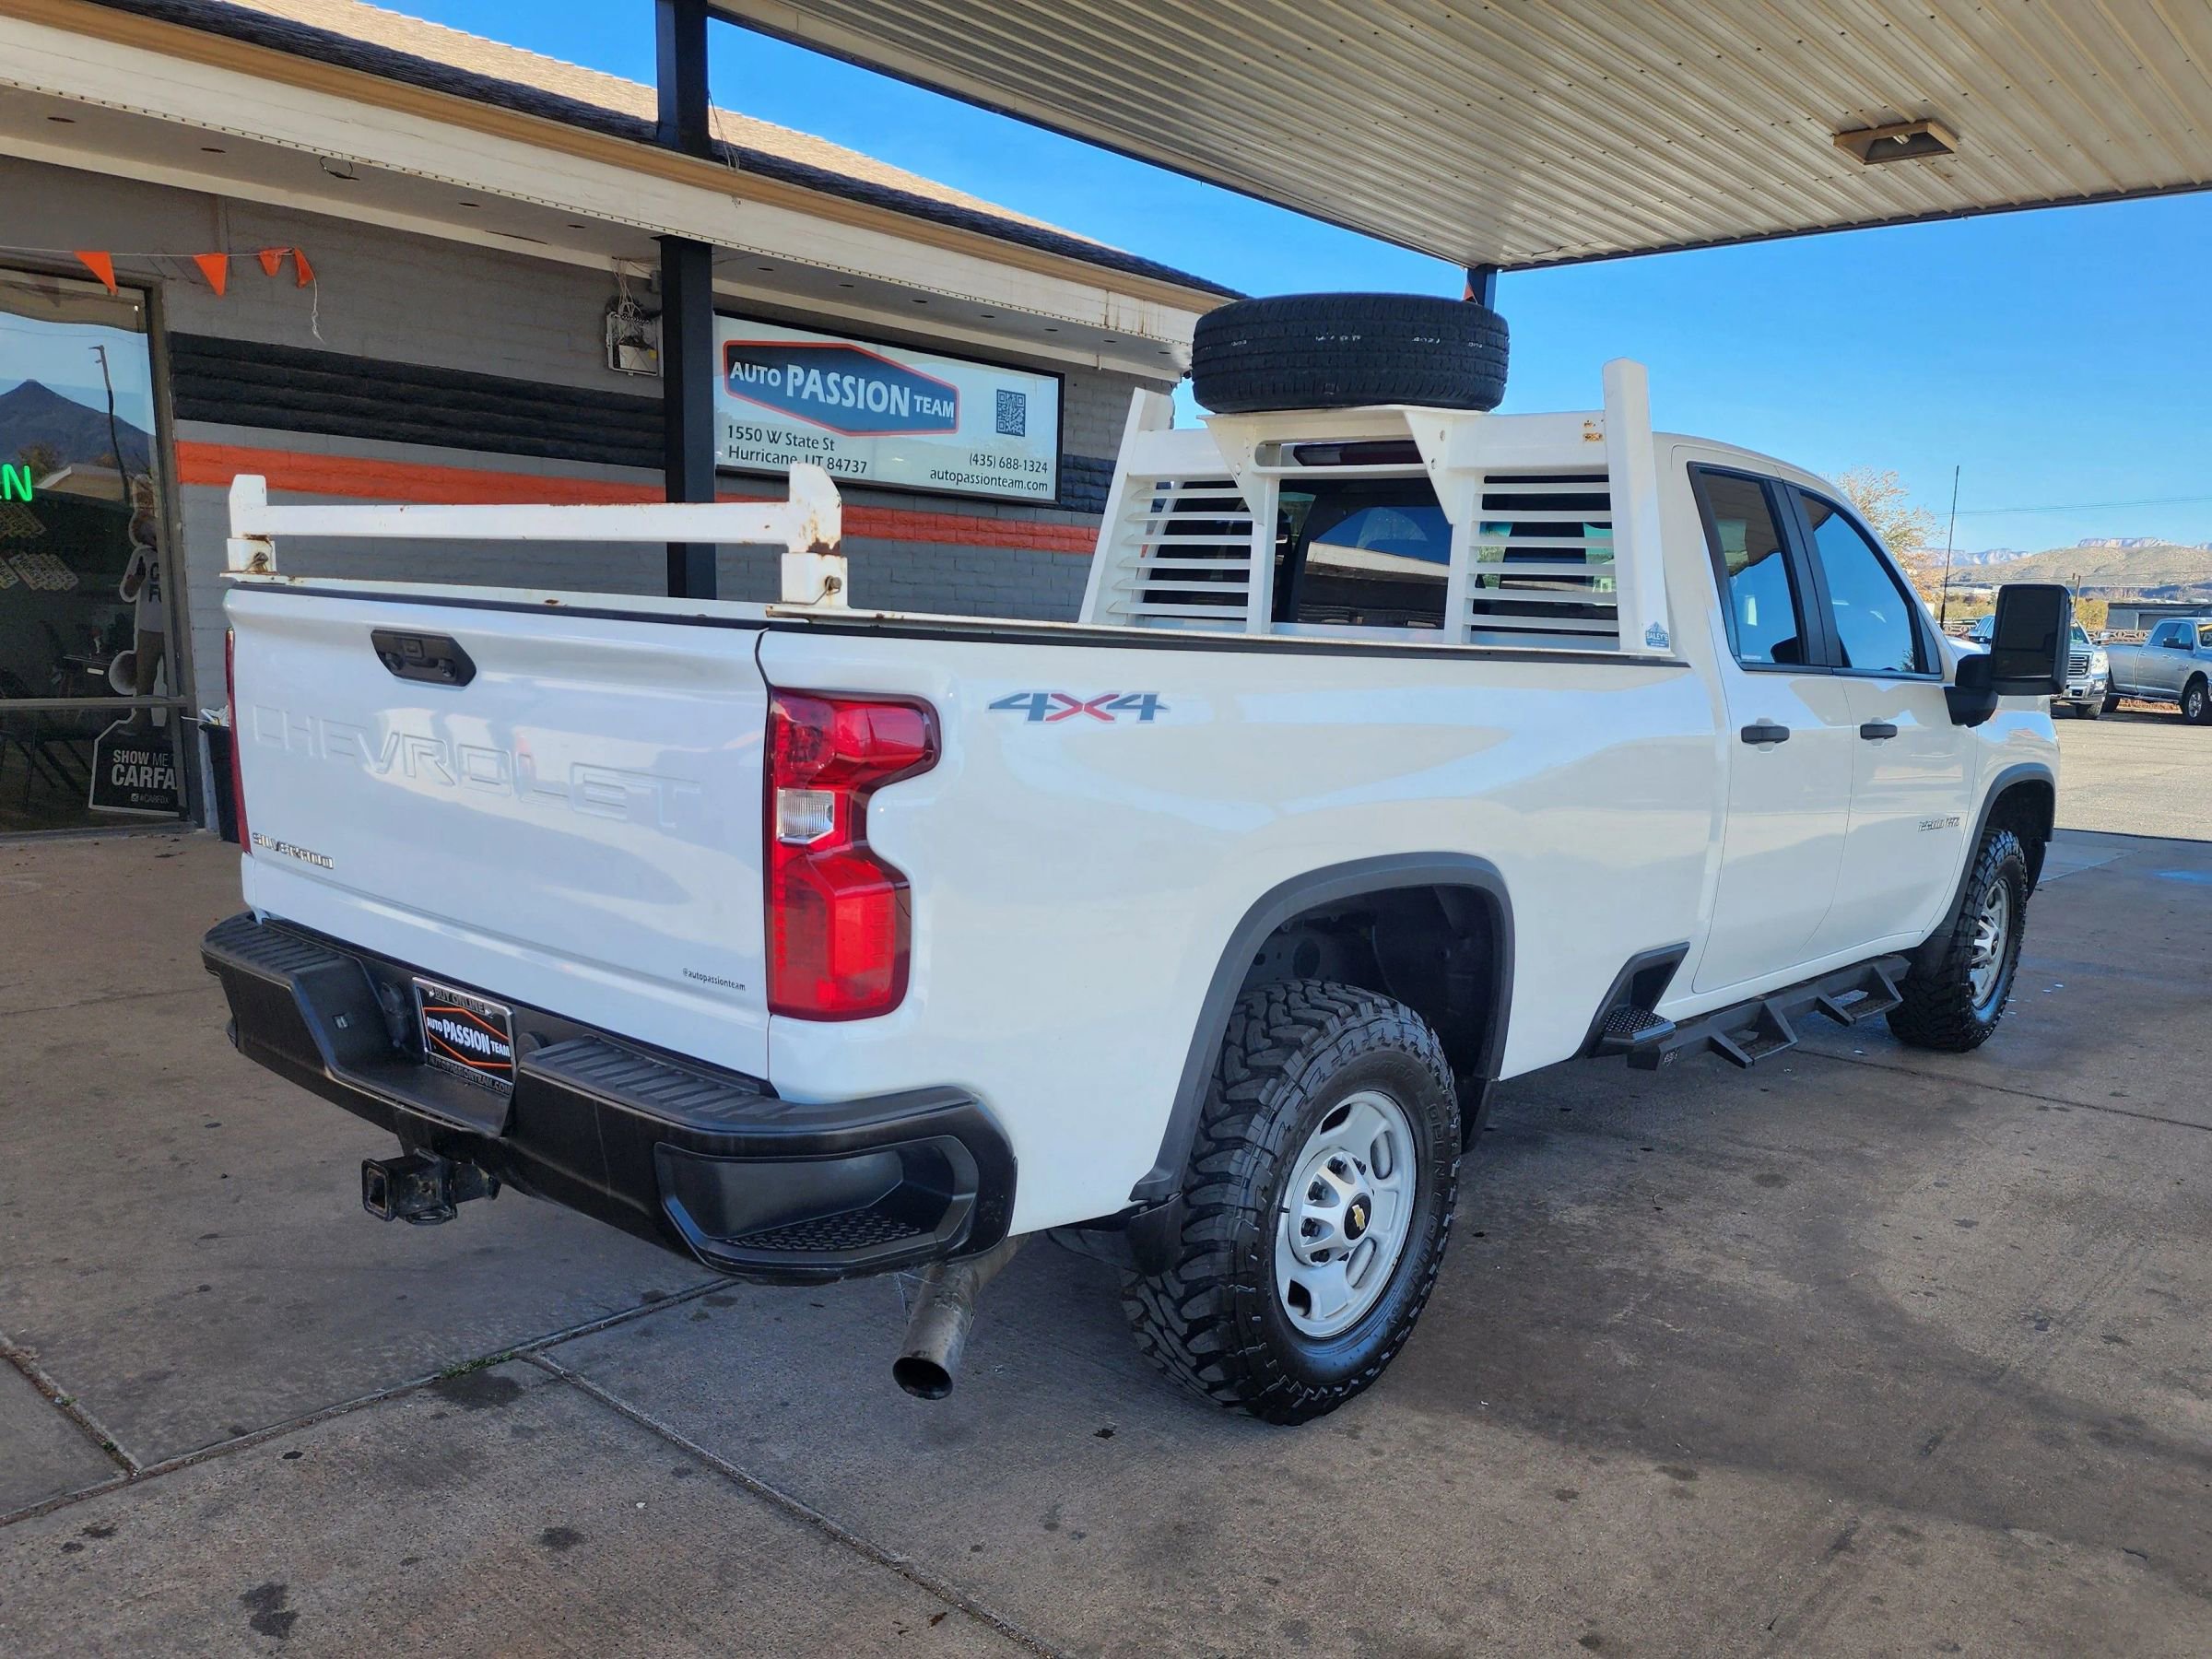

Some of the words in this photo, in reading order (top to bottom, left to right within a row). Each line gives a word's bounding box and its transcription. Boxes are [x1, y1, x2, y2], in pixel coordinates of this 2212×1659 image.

[730, 361, 782, 387] AUTO
[786, 364, 911, 418] PASSION
[914, 394, 955, 418] TEAM
[728, 425, 762, 442] 1550
[767, 429, 782, 444] W
[785, 432, 819, 449] State
[823, 437, 835, 452] St
[805, 454, 824, 466] UT
[827, 457, 867, 474] 84737
[970, 453, 996, 468] (435)
[999, 456, 1048, 474] 688-1324
[0, 464, 33, 501] N
[930, 469, 1048, 491] autopassionteam.com
[112, 749, 149, 765] SHOW
[152, 752, 169, 766] ME
[253, 704, 701, 829] CHEVROLET
[112, 763, 178, 790] CARFA
[253, 832, 335, 870] SILVERADO
[682, 968, 746, 991] @autopassionteam
[427, 1017, 442, 1032] AUTO
[442, 1019, 491, 1054] PASSION
[490, 1040, 511, 1057] TEAM
